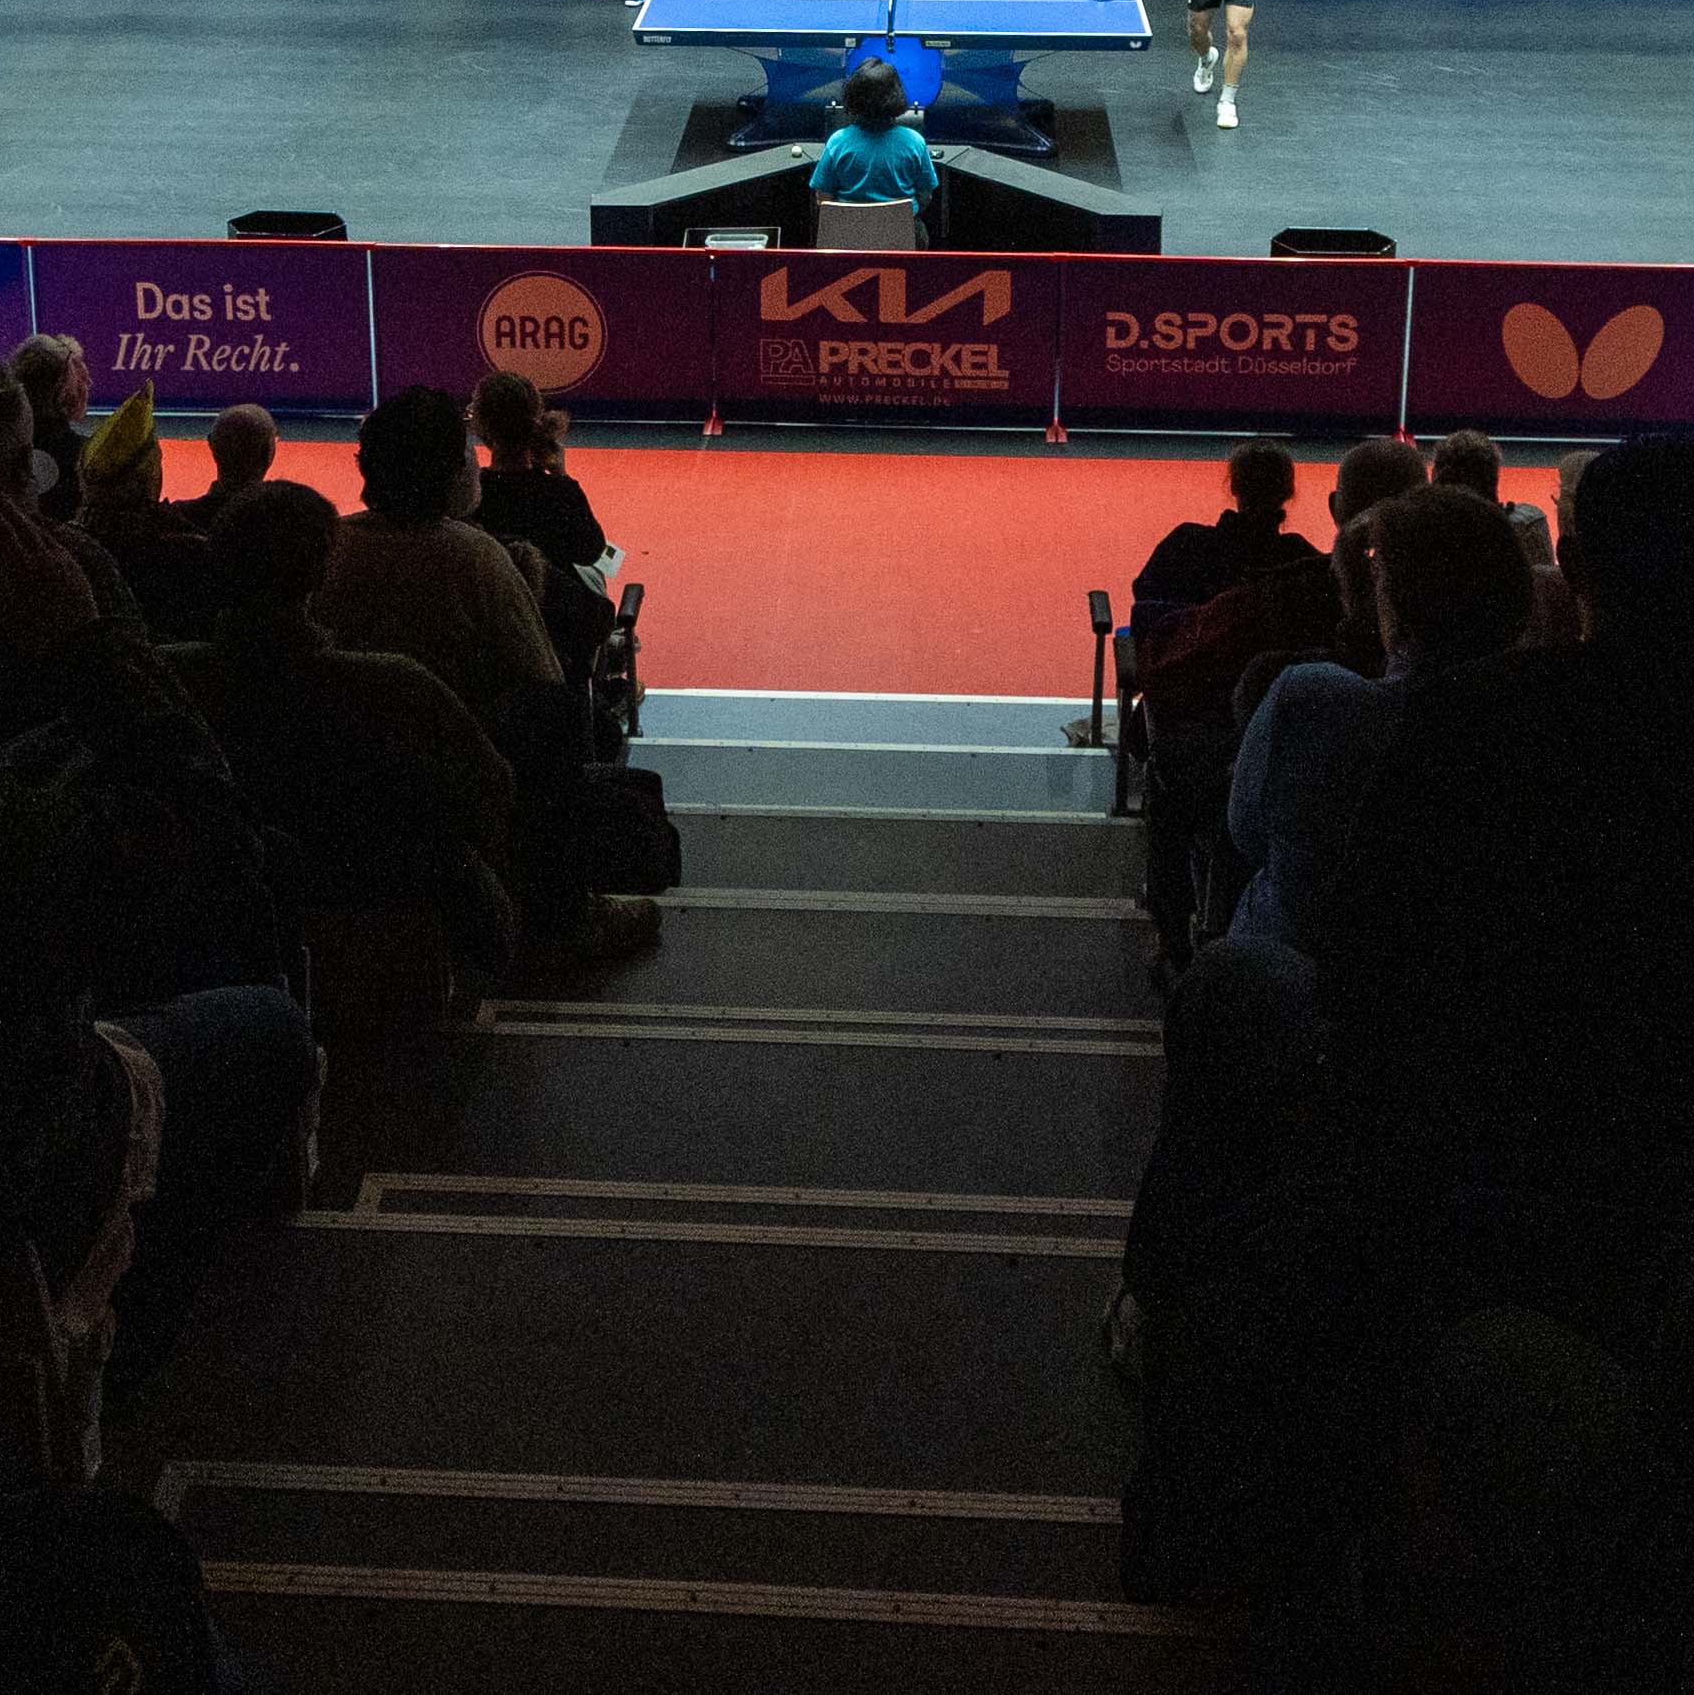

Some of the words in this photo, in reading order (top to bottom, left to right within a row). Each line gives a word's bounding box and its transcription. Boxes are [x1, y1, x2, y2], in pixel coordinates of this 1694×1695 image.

[134, 281, 214, 322] Das
[223, 282, 273, 322] ist
[760, 266, 1012, 326] KIA
[111, 332, 174, 372] Ihr
[181, 334, 301, 373] Recht.
[494, 315, 591, 351] ARAG
[1106, 311, 1360, 353] D.SPORTS
[819, 340, 1011, 378] PRECKEL
[1106, 354, 1232, 377] Sportstadt
[1238, 355, 1358, 376] Düsseldorf
